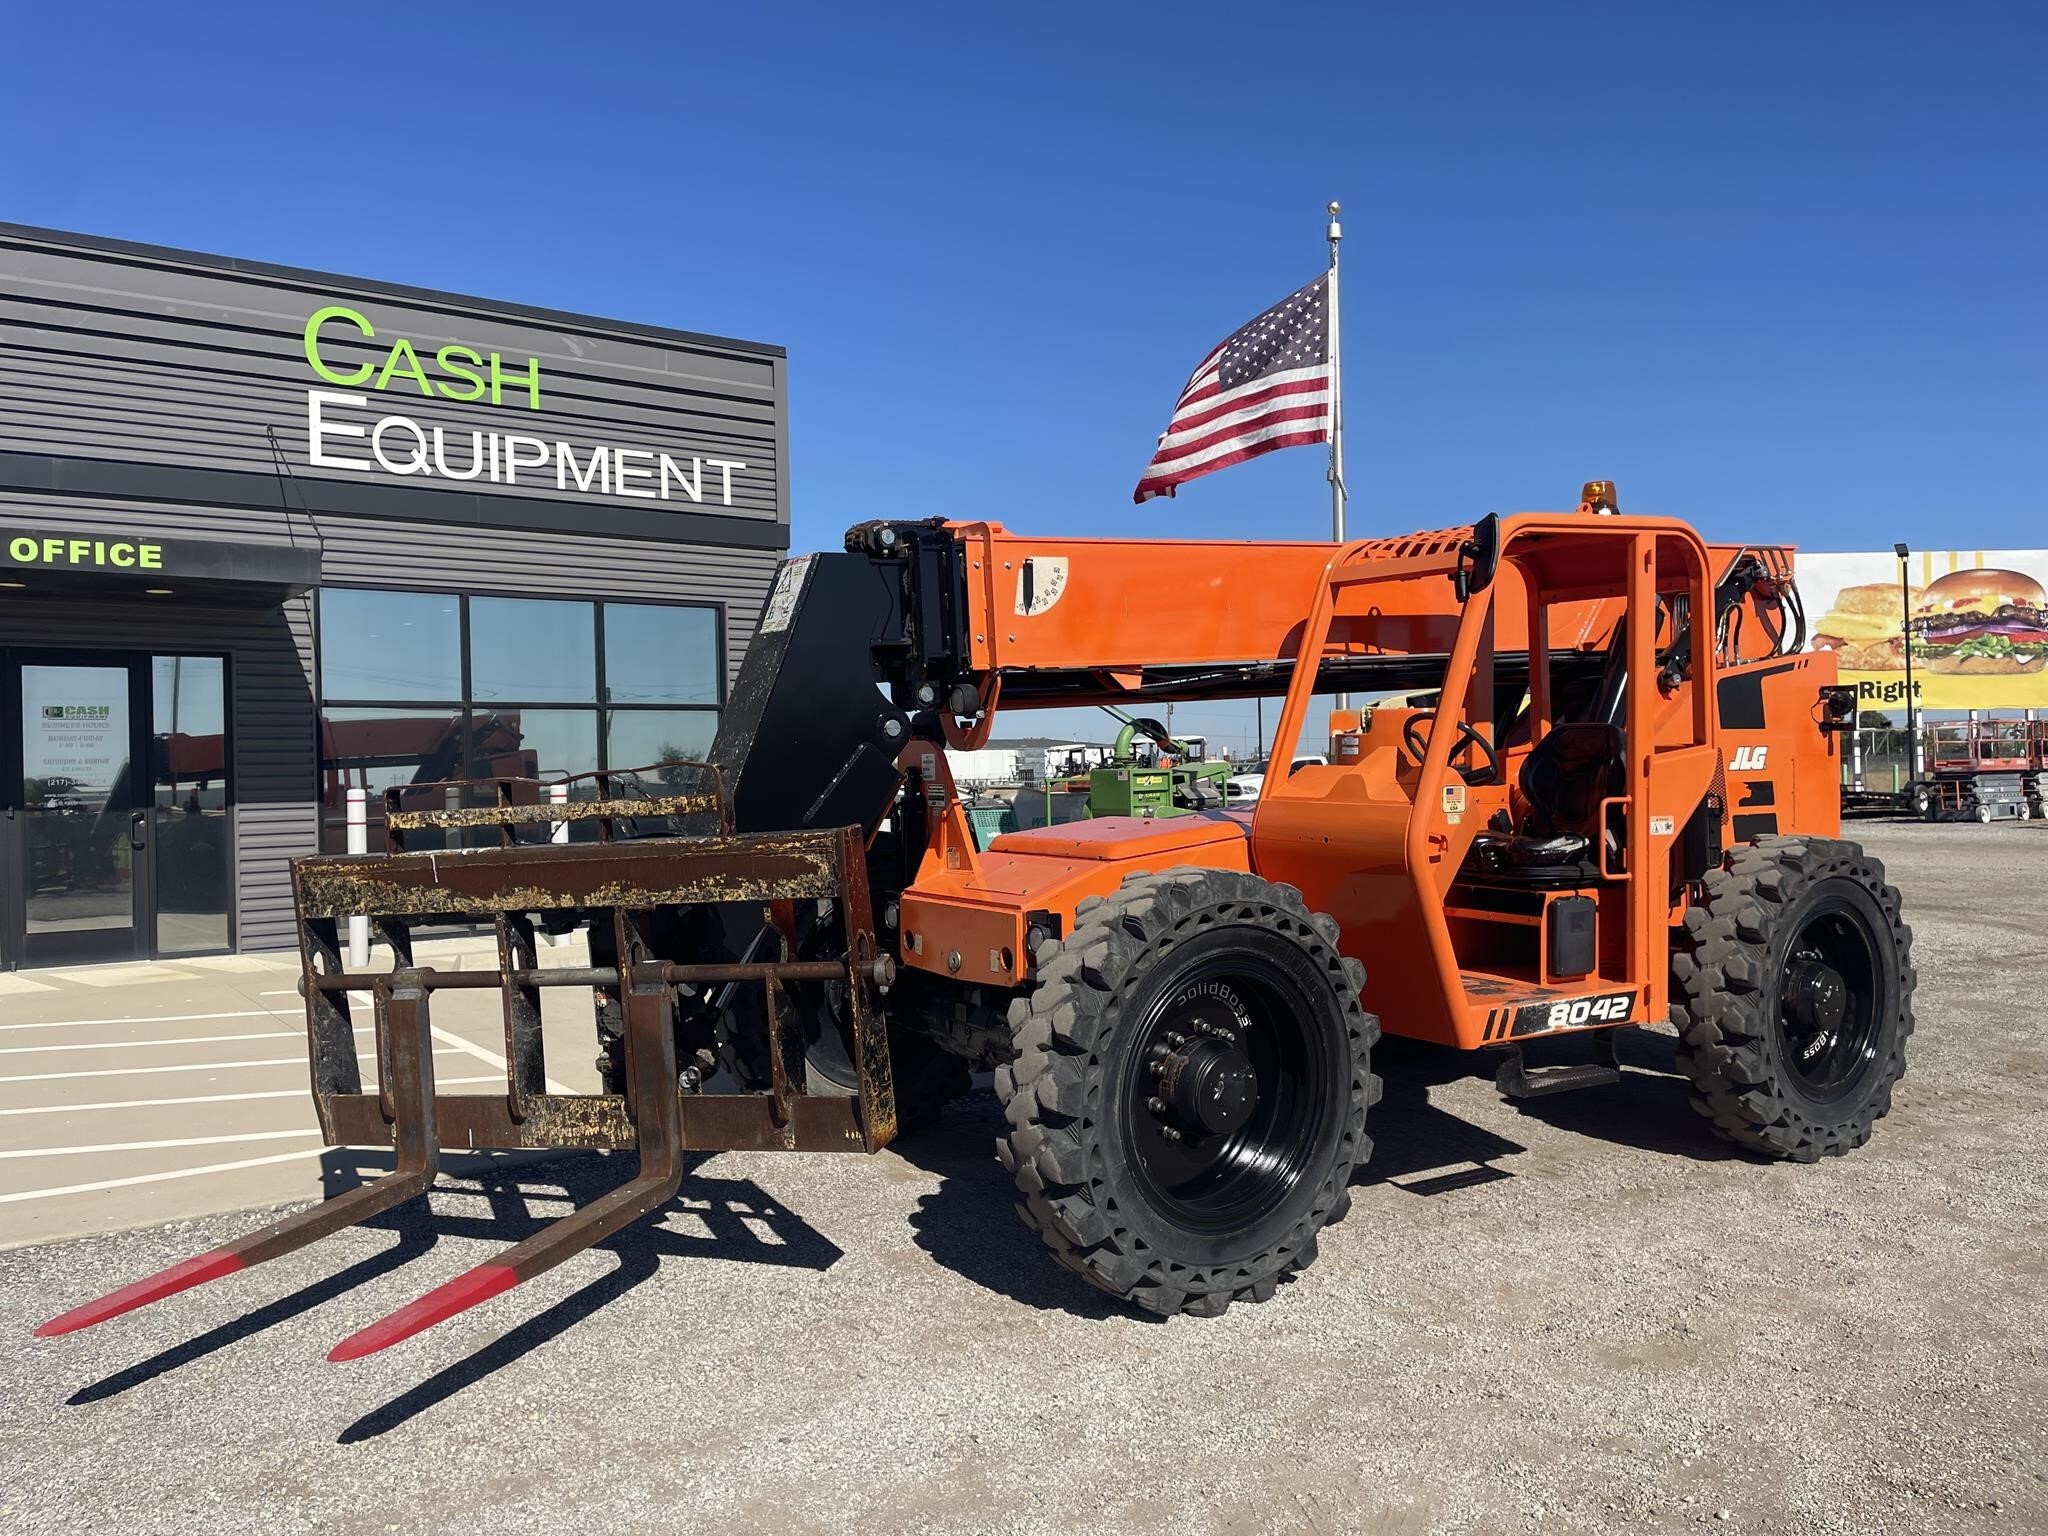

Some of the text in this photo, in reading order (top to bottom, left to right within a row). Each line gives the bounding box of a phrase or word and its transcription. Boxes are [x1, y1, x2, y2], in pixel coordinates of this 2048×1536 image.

[304, 306, 540, 410] CASH
[308, 390, 746, 505] EQUIPMENT
[9, 537, 162, 569] OFFICE
[1859, 680, 1922, 702] Right
[64, 706, 109, 715] CASH
[1728, 746, 1767, 771] JLG
[1548, 997, 1629, 1028] 8042
